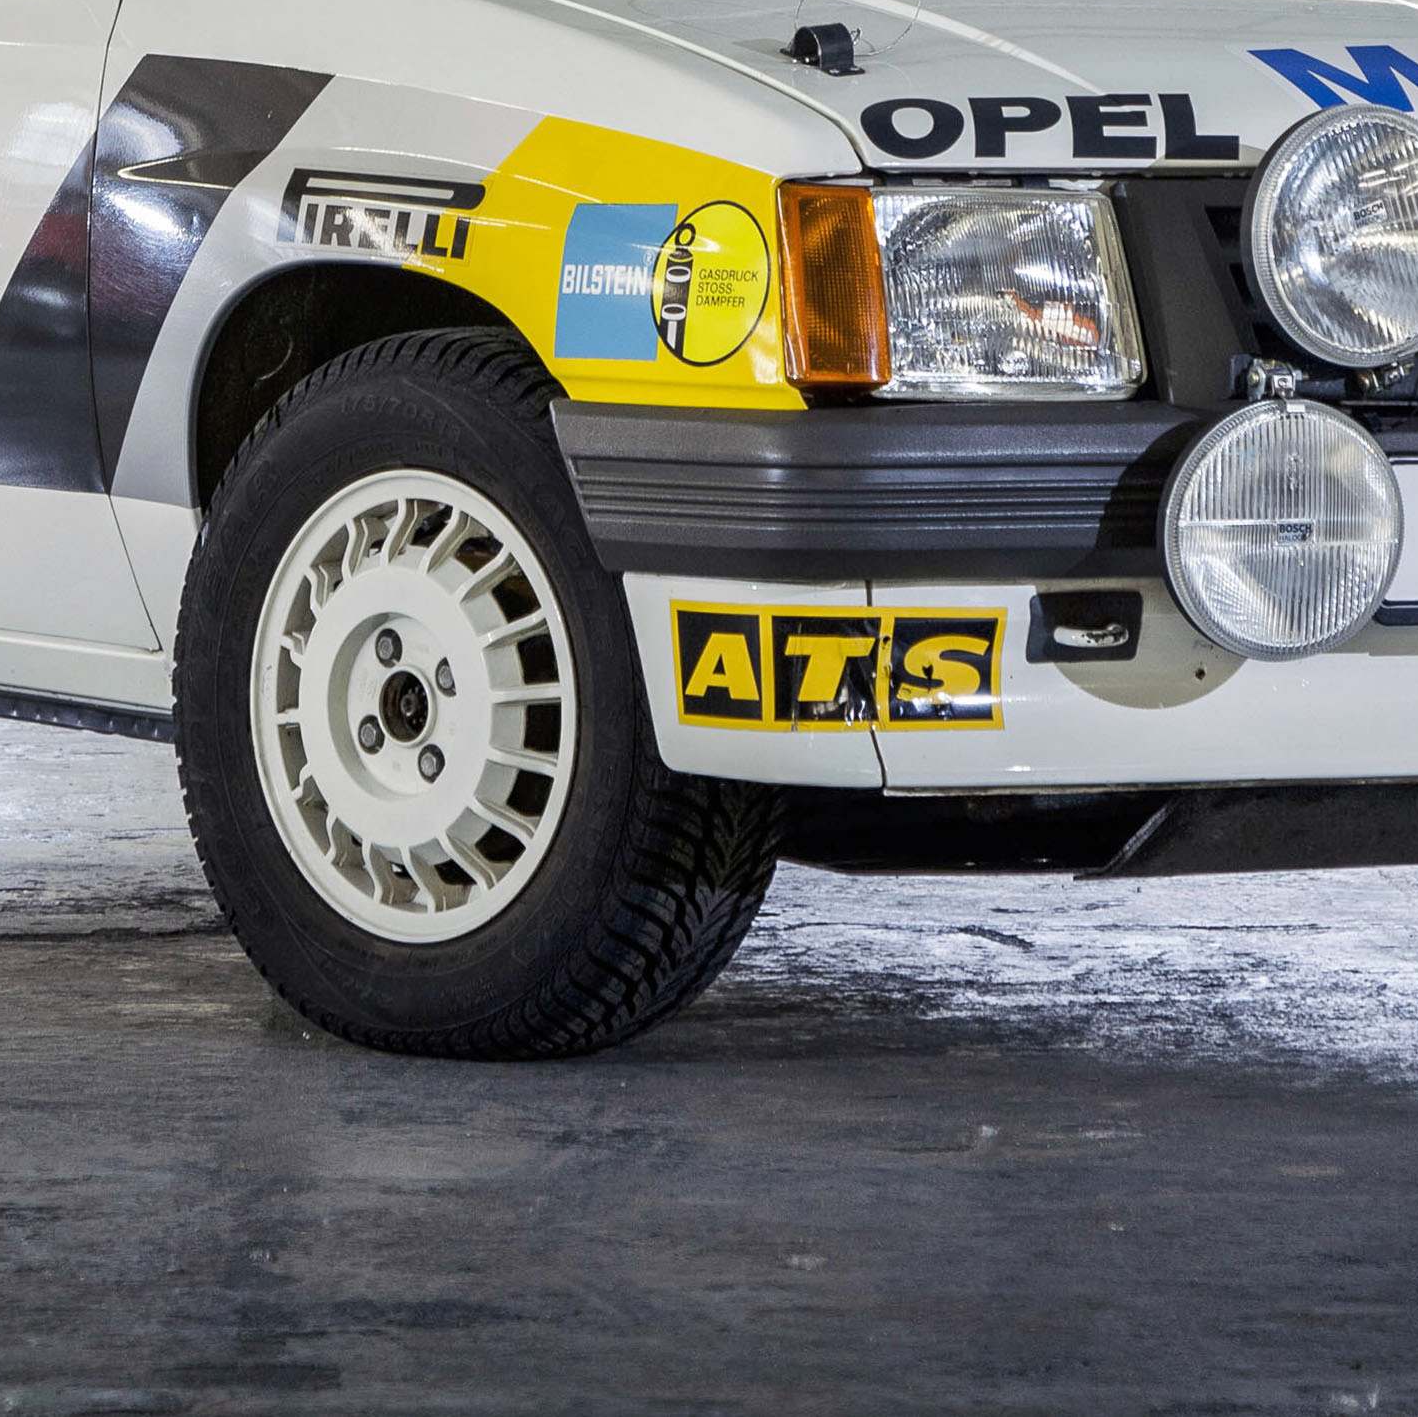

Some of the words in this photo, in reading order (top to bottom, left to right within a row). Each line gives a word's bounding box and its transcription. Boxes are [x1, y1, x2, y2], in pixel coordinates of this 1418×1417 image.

[859, 92, 1241, 161] OPEL
[275, 167, 487, 261] PIRELLI
[698, 268, 760, 282] GASDRUCK
[684, 631, 991, 706] ATS
